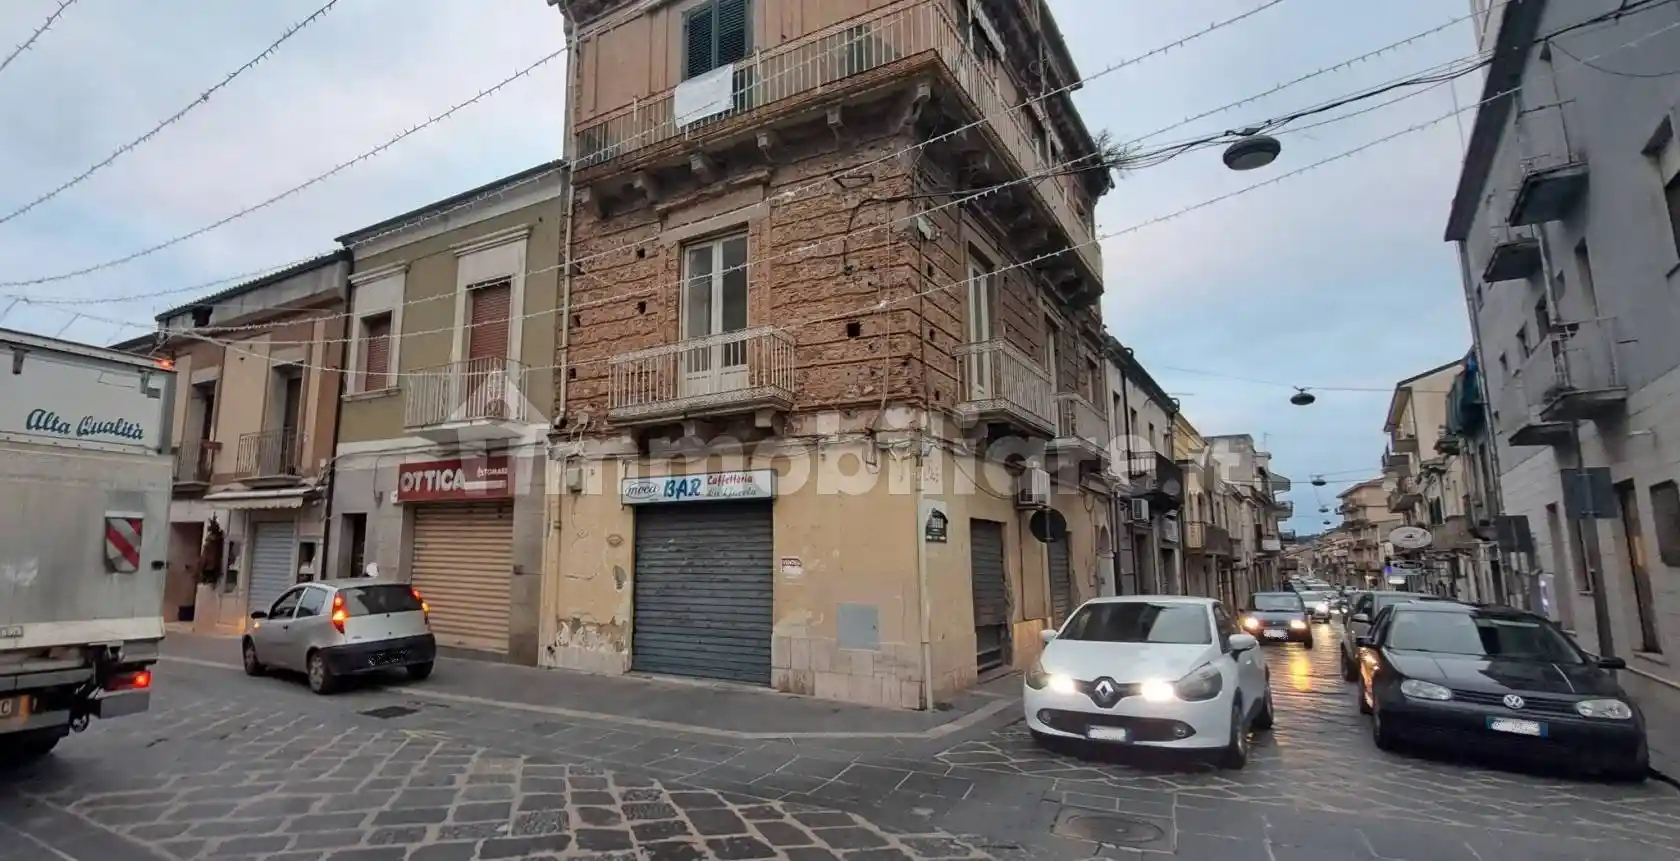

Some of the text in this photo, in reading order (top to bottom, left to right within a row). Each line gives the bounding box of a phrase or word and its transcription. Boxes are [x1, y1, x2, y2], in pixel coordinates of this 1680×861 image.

[26, 408, 144, 440] Alta Qualità
[400, 468, 466, 492] OTTICA
[663, 478, 702, 499] BAR
